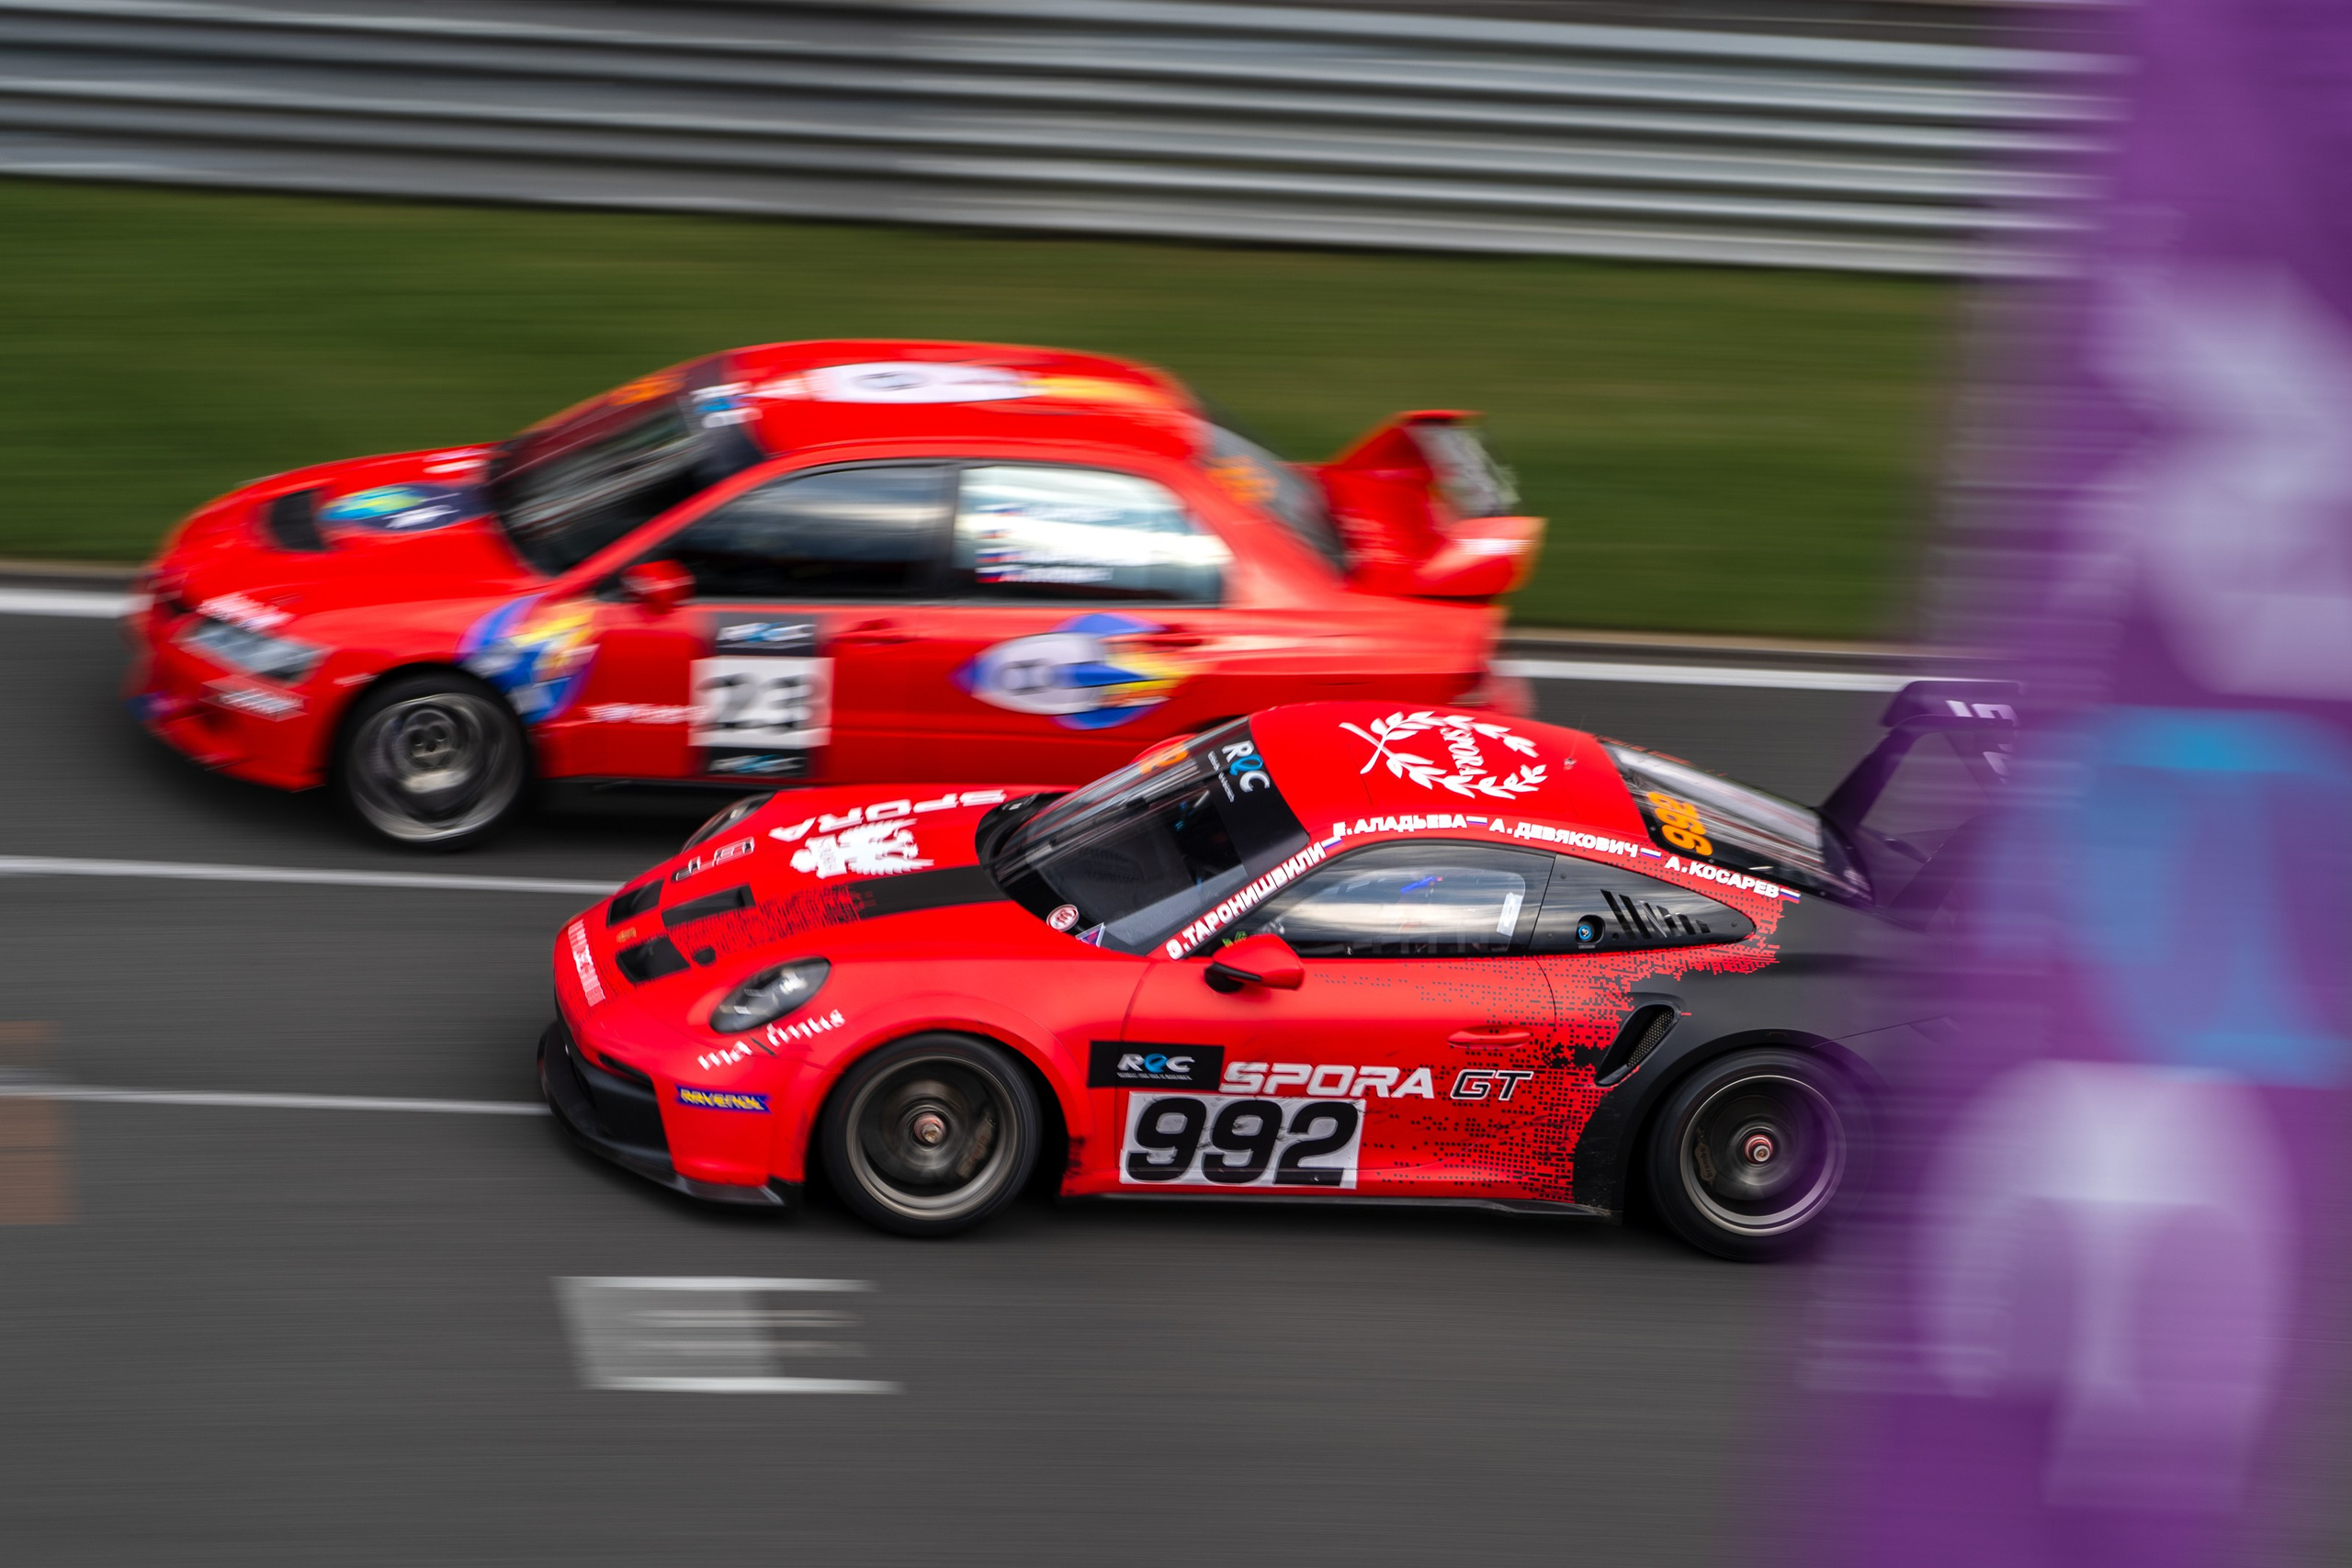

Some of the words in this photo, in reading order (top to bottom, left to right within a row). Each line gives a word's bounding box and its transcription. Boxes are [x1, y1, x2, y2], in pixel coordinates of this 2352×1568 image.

[768, 789, 1008, 843] SPORA
[1646, 791, 1713, 856] 992
[1665, 855, 1781, 899] А.КОСАРЕВ
[1219, 1061, 1434, 1100] SPORA
[1451, 1068, 1534, 1101] GT
[1125, 1097, 1358, 1187] 992
[1700, 1147, 1713, 1179] brembo
